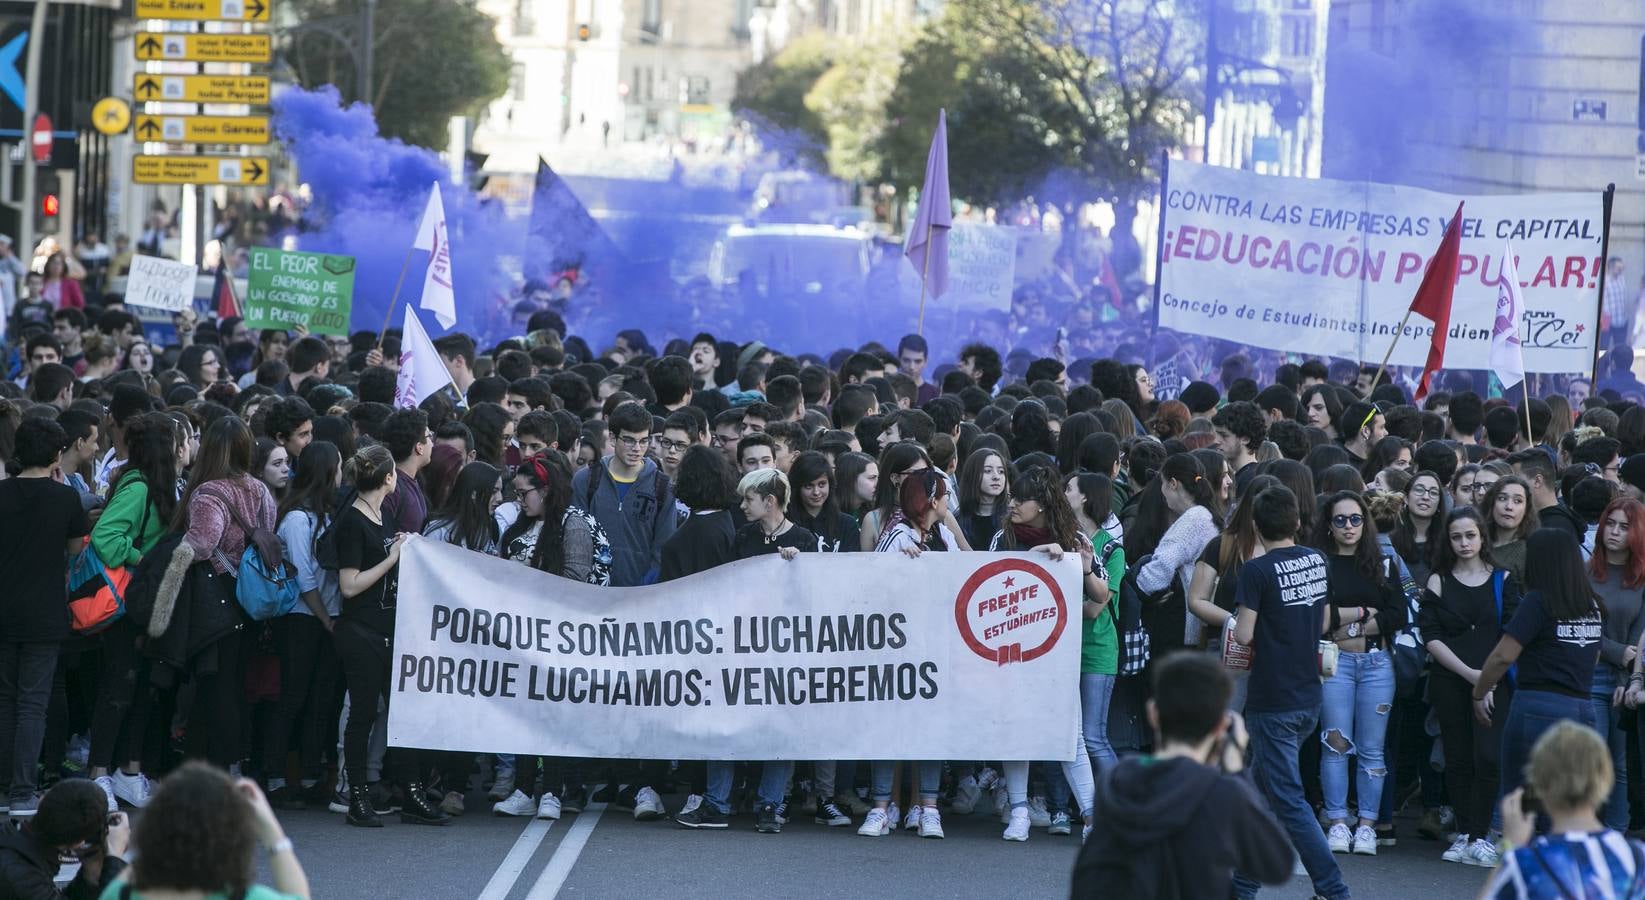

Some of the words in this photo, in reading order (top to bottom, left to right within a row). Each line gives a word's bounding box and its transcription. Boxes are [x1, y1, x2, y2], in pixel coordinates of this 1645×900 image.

[1167, 189, 1252, 219] CONTRA
[1260, 202, 1302, 225] LAS
[1309, 208, 1429, 236] EMPRESAS
[1461, 217, 1486, 238] EL
[1496, 217, 1601, 244] CAPITAL,
[253, 252, 273, 270] EL
[280, 254, 318, 275] PEOR
[1162, 225, 1387, 284] ¡EDUCACIÓN
[271, 274, 320, 293] ENEMIGO
[323, 280, 338, 294] DE
[250, 289, 265, 301] UN
[322, 296, 338, 310] ES
[249, 306, 264, 321] UN
[270, 306, 309, 325] PUEBLO
[1163, 292, 1228, 318] Concejo
[1235, 304, 1256, 320] de
[1263, 307, 1366, 334] Estudiantes
[1274, 562, 1283, 574] A
[1281, 555, 1311, 573] LUCHAR
[1308, 553, 1325, 566] POR
[1278, 575, 1290, 588] LA
[1290, 565, 1327, 586] EDUCACIÓN
[978, 584, 1039, 617] FRENTE
[1281, 587, 1298, 602] QUE
[1297, 580, 1328, 599] SOÑAMOS
[1005, 605, 1019, 617] de
[431, 605, 552, 653] PORQUE
[557, 617, 724, 657] SOÑAMOS:
[734, 612, 908, 654] LUCHAMOS
[1557, 625, 1573, 637] QUE
[398, 654, 519, 698] PORQUE
[527, 665, 712, 707] LUCHAMOS:
[721, 661, 939, 706] VENCEREMOS
